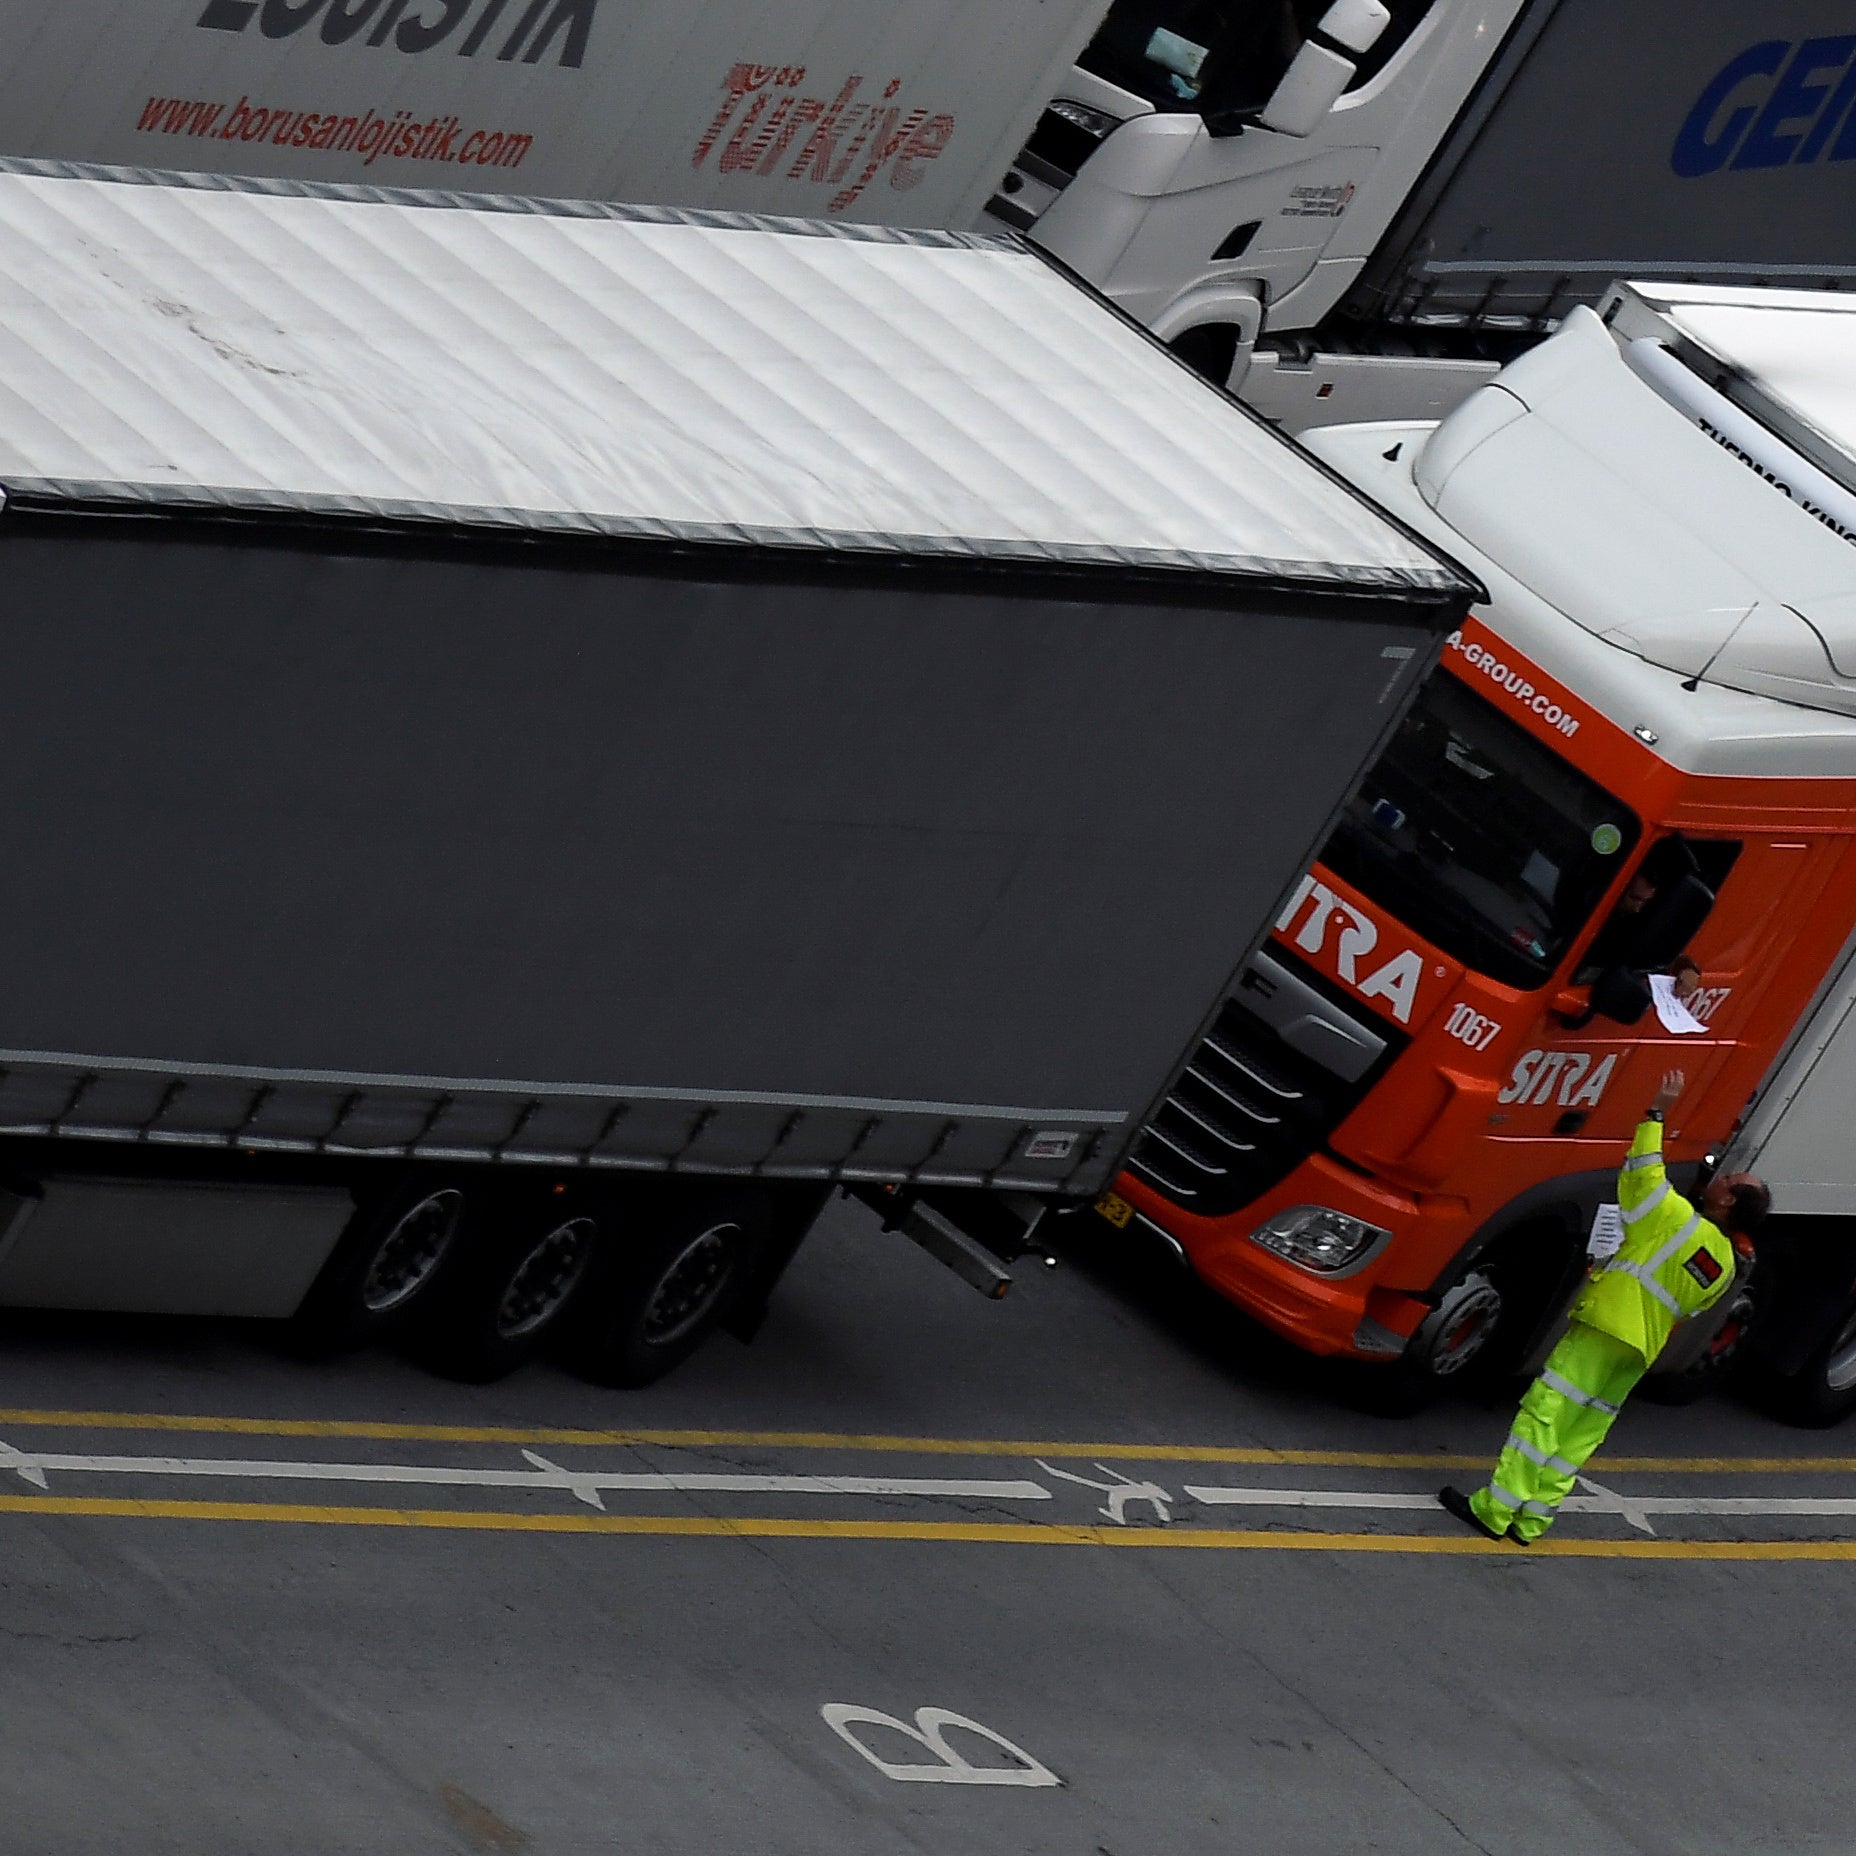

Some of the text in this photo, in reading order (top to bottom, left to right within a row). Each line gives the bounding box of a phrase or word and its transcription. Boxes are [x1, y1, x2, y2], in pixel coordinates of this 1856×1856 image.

[137, 95, 533, 168] www.borusanlojistik.com
[1445, 630, 1581, 738] A-GROUP.COM
[1275, 873, 1427, 1024] ITRA
[1443, 1002, 1502, 1052] 1067
[1685, 987, 1732, 1022] 067
[1498, 1048, 1618, 1107] SITRA
[819, 1701, 1063, 1787] B
